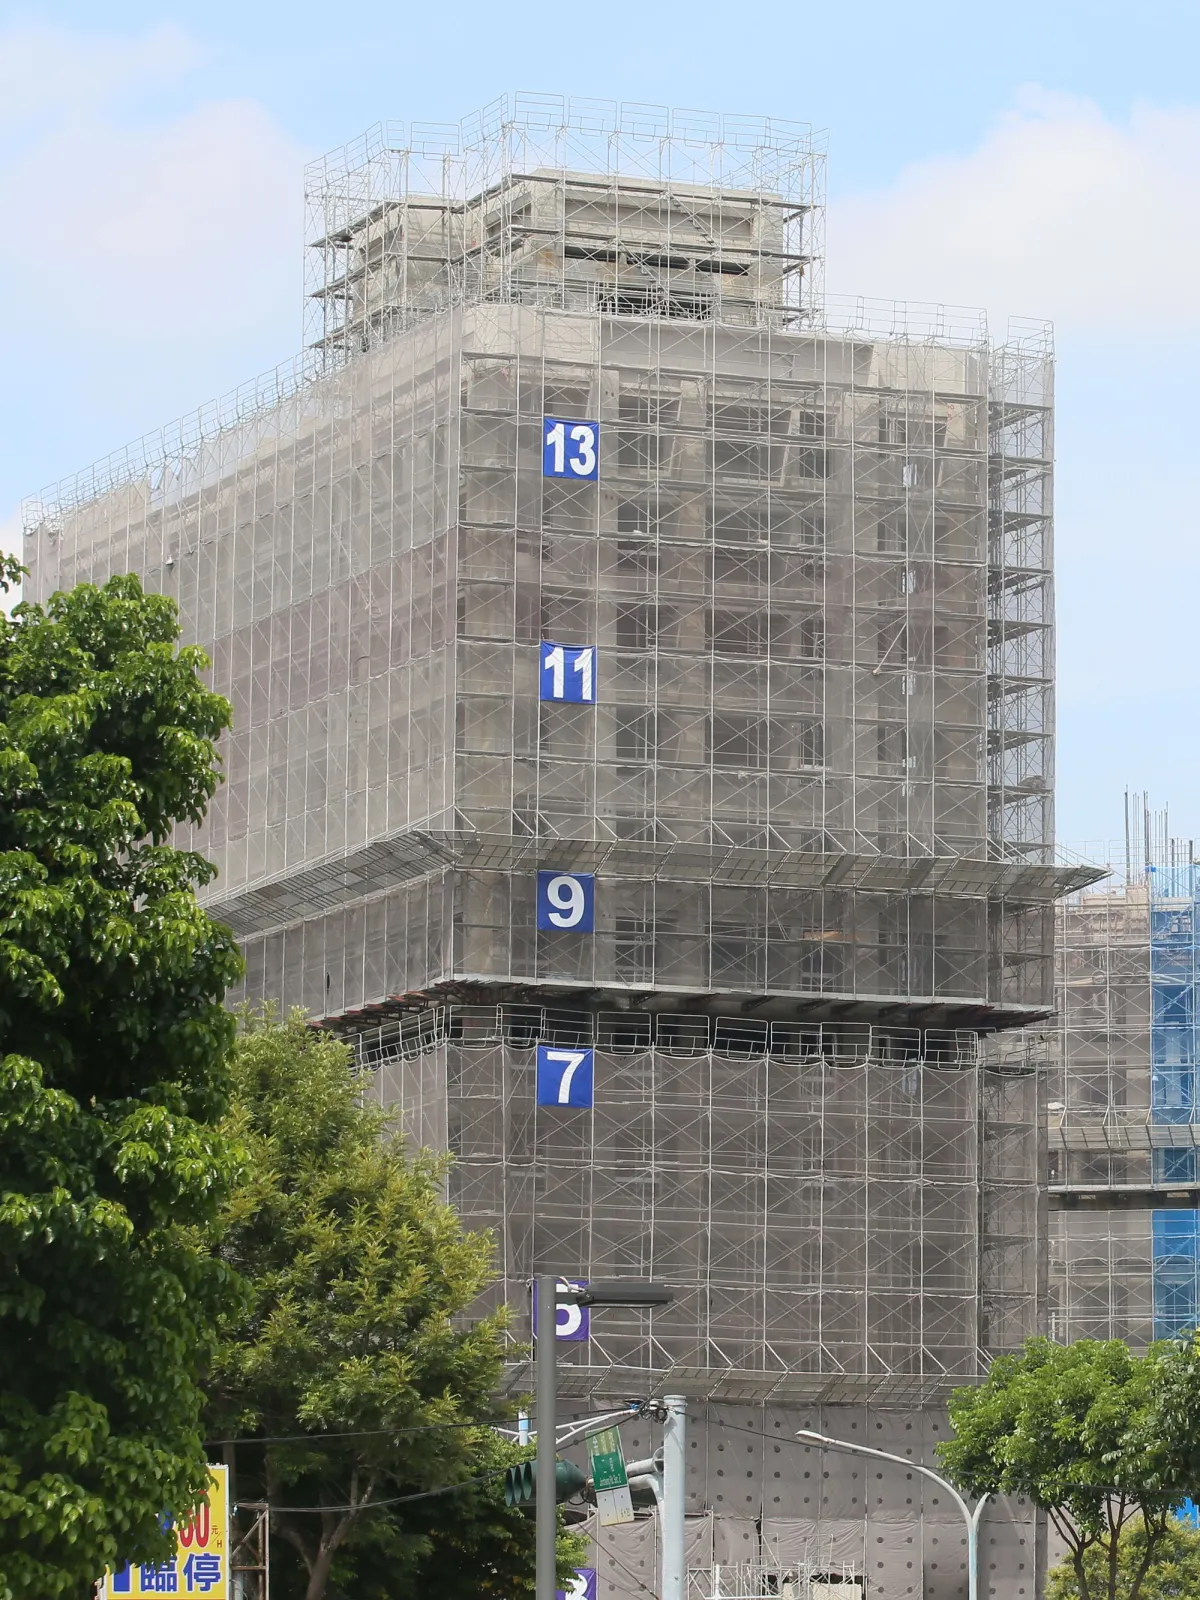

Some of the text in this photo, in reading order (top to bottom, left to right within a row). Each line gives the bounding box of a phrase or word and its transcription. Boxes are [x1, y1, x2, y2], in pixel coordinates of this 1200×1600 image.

[547, 423, 596, 476] 13
[545, 646, 592, 700] 11
[547, 876, 585, 928] 9
[547, 1051, 585, 1104] 7
[140, 1553, 221, 1592] 臨停
